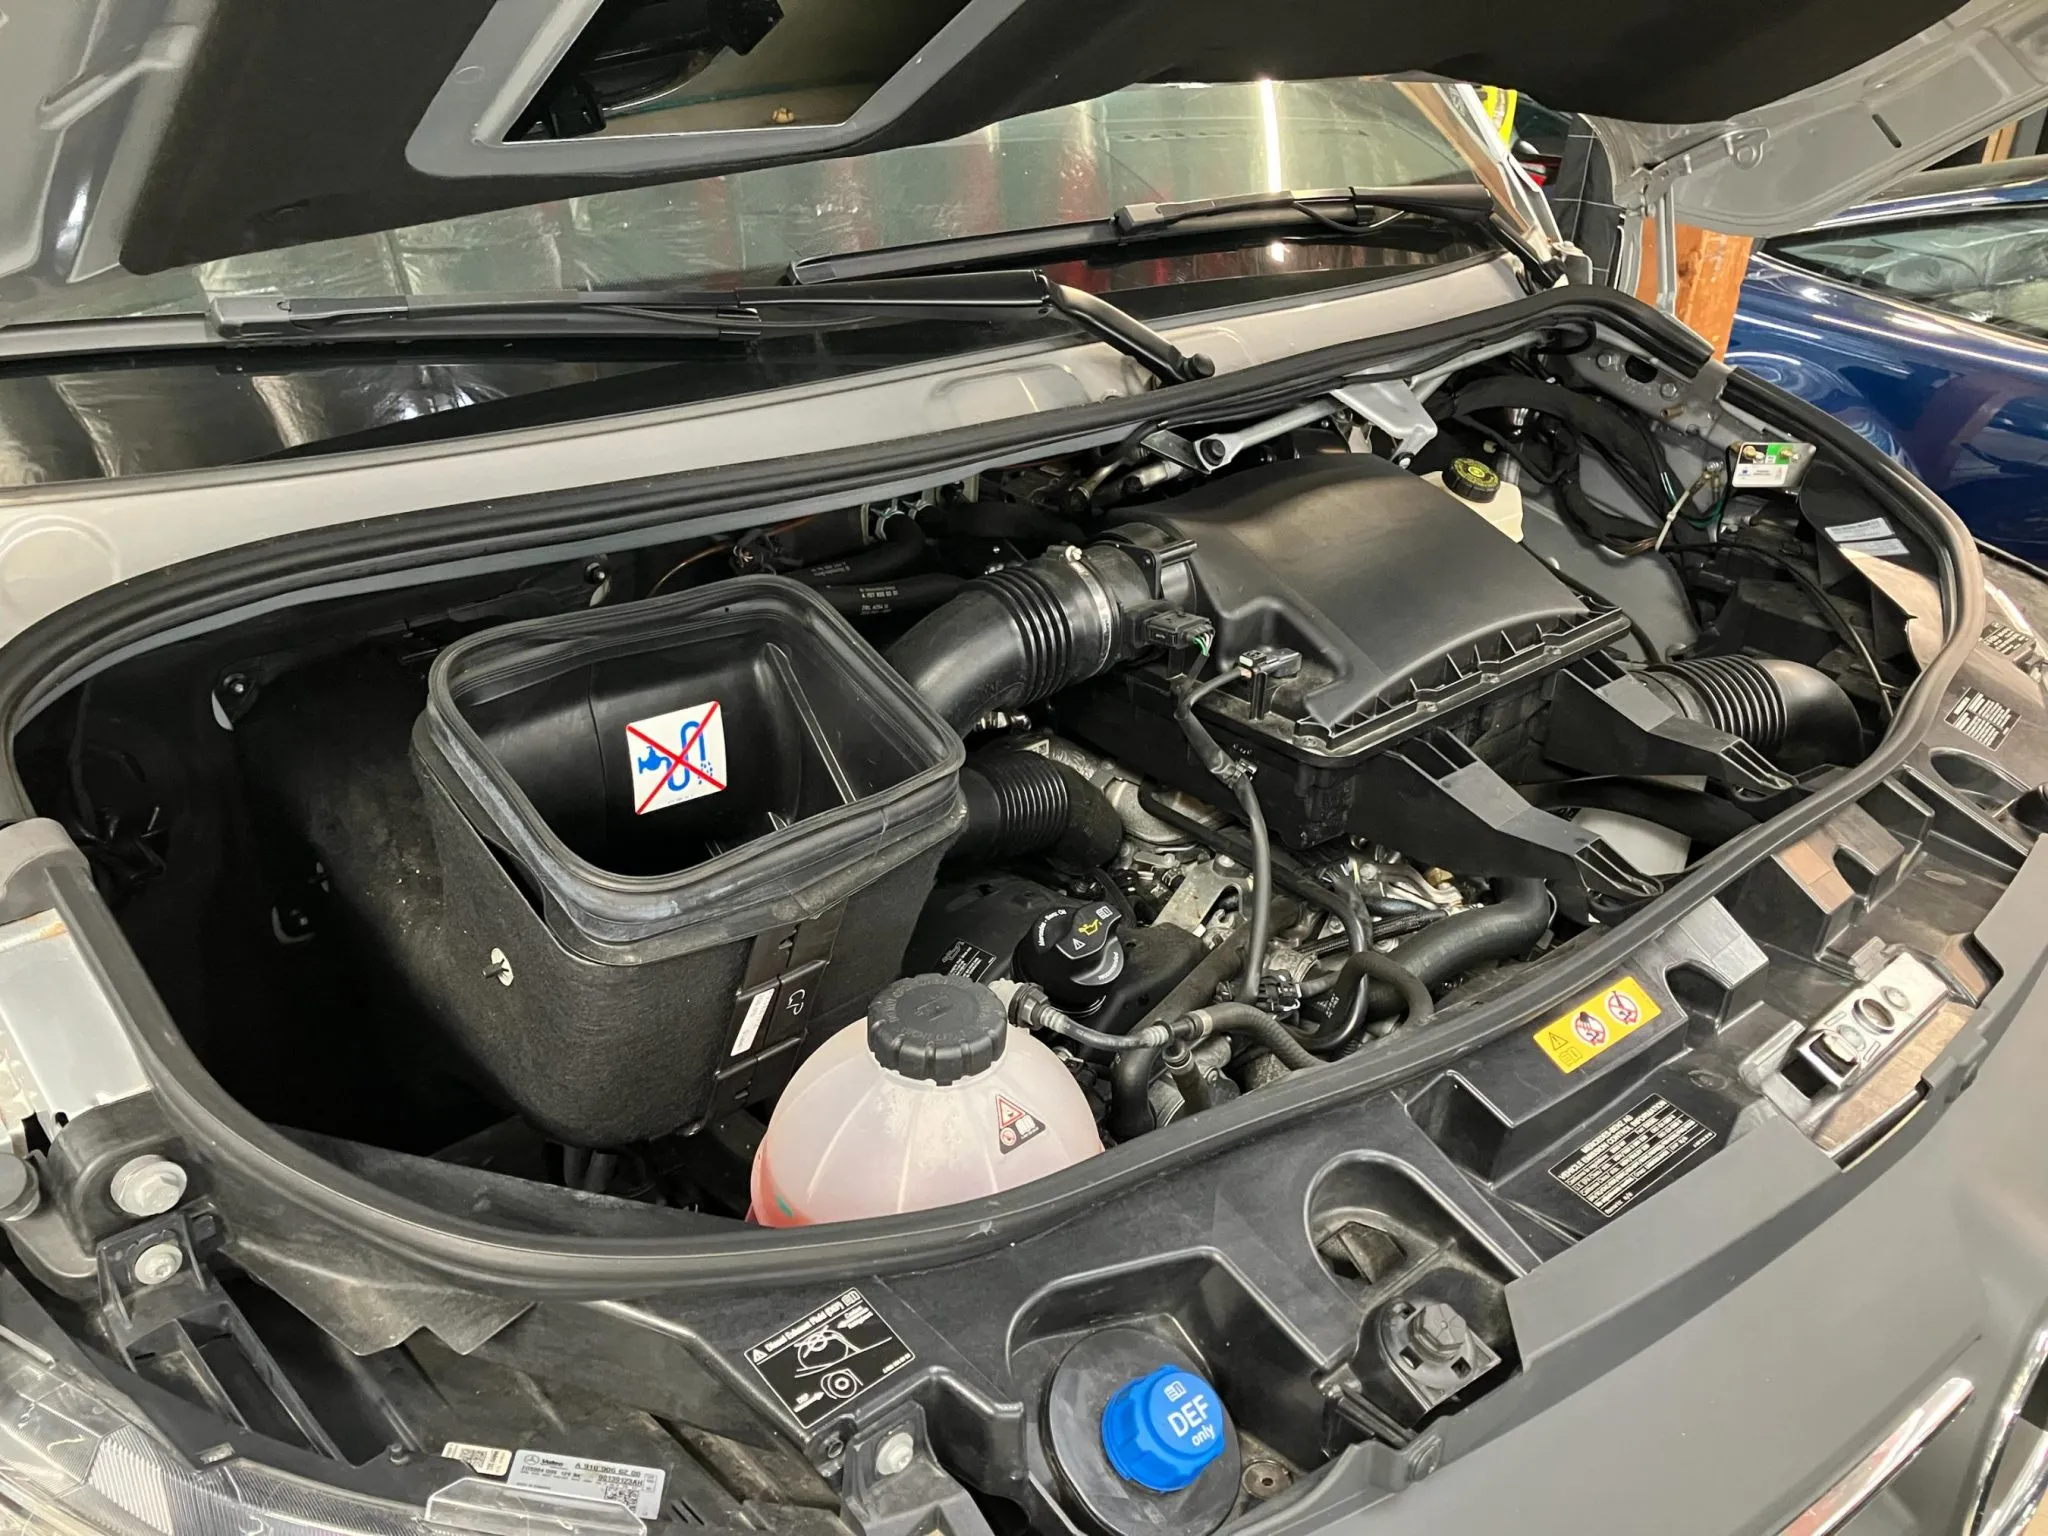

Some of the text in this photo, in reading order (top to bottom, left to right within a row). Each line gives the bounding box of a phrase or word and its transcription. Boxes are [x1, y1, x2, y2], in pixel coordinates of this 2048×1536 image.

[1557, 1160, 1584, 1180] VEHICLE
[1605, 1124, 1633, 1144] CONTROL
[1629, 1099, 1667, 1127] INFORMATION
[763, 1334, 788, 1352] Diesel
[784, 1319, 812, 1340] Exhaust
[808, 1311, 827, 1325] Fluid
[1167, 1394, 1209, 1438] DEF
[1191, 1424, 1216, 1447] only
